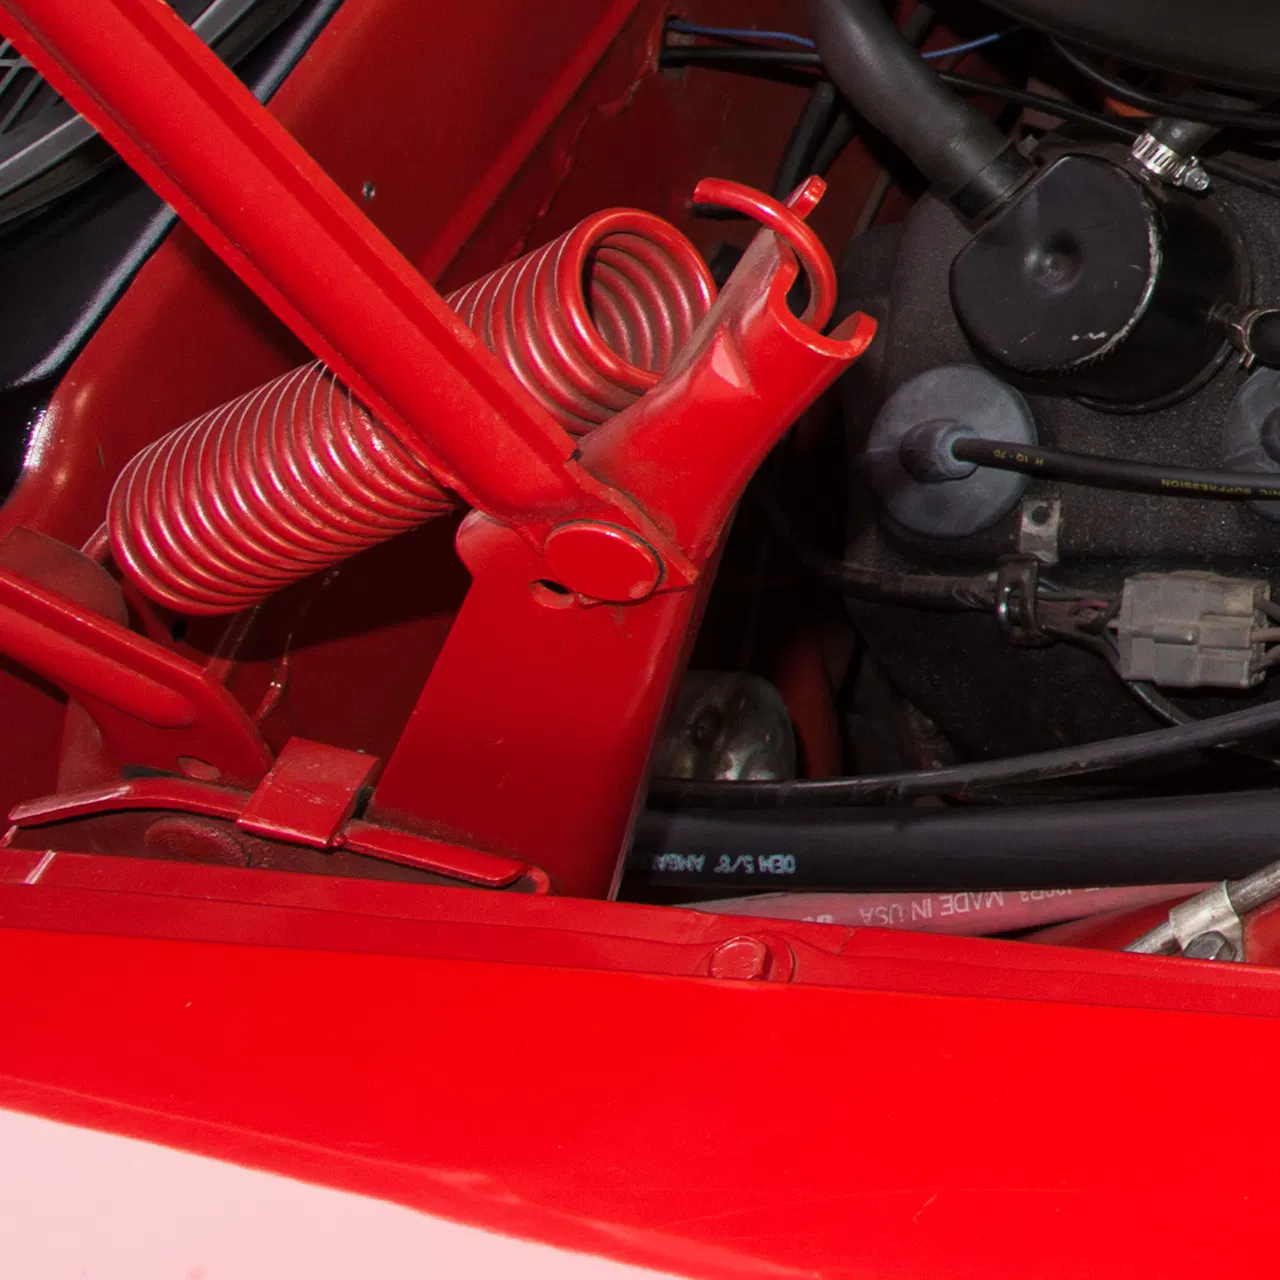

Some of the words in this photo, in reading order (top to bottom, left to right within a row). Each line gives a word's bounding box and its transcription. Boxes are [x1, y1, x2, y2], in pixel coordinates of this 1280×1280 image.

[758, 853, 797, 874] OEM
[860, 903, 903, 926] USA
[911, 903, 933, 922] IN
[940, 890, 1005, 917] MADE
